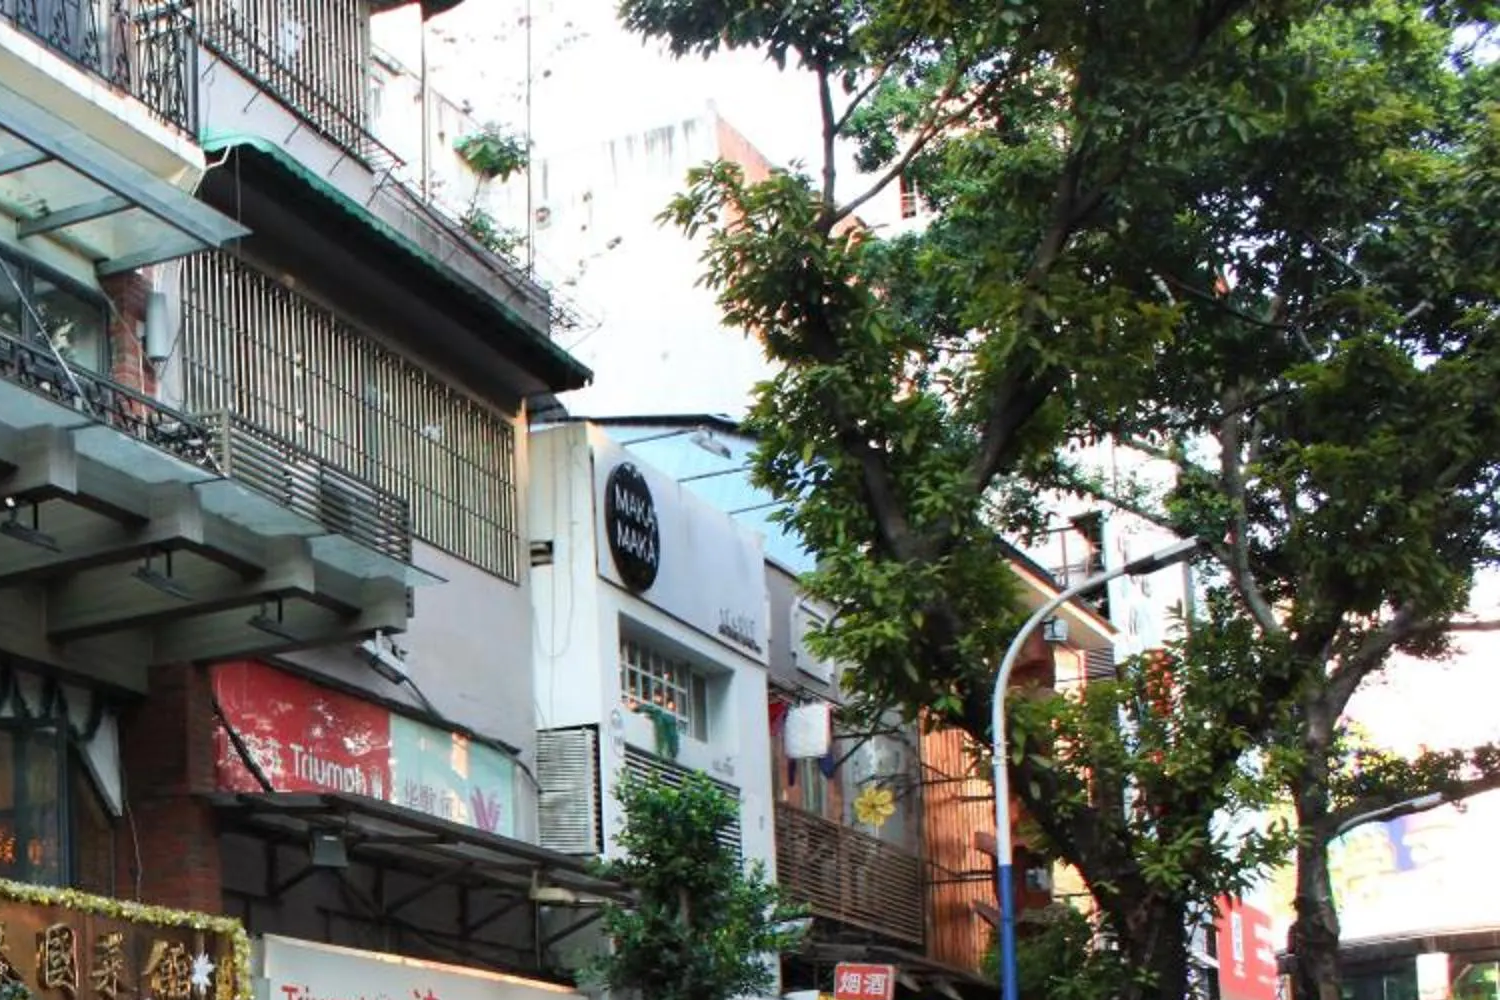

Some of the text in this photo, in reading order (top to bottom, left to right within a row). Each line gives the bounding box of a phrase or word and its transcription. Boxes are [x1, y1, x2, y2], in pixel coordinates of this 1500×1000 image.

[615, 483, 656, 528] MAKA
[617, 519, 657, 566] MAKA
[289, 743, 367, 794] Triumph
[839, 972, 887, 995] 烟酒
